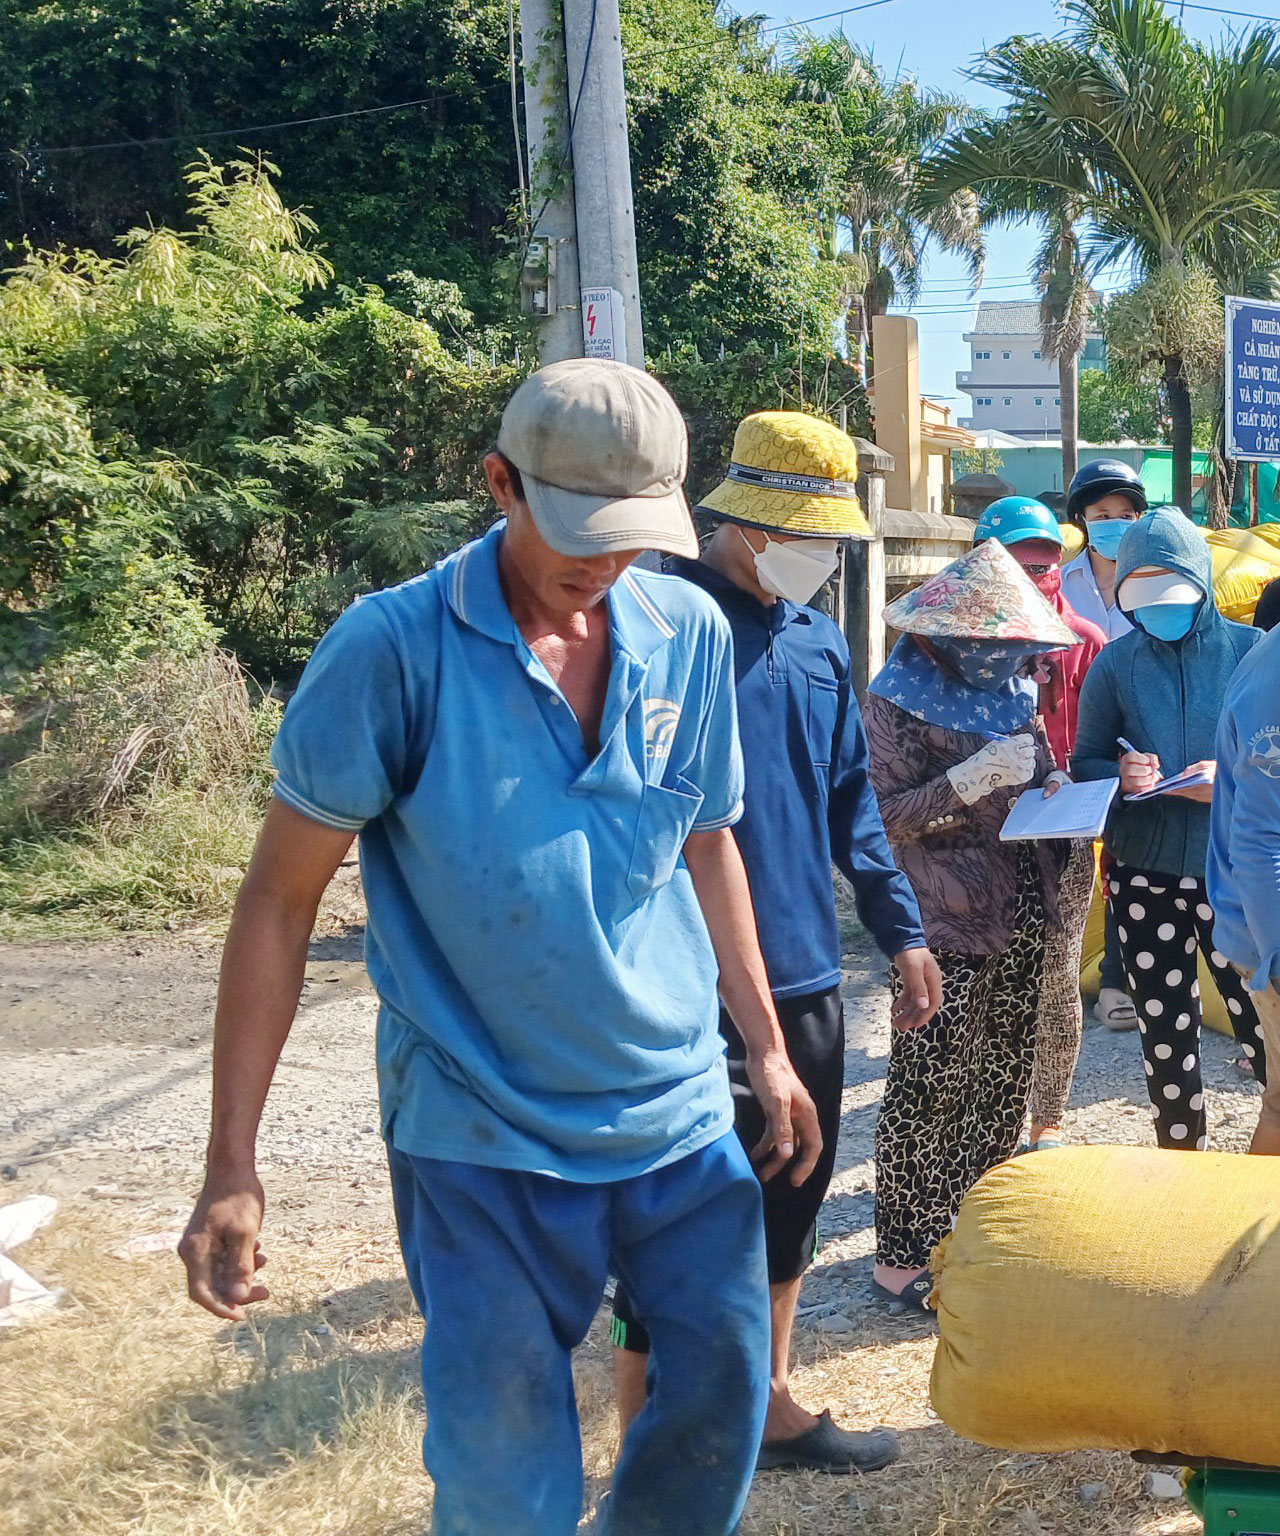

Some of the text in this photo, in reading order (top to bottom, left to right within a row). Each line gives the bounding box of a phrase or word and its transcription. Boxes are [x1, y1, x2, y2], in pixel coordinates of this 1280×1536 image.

[1244, 336, 1256, 356] CÁ
[1257, 340, 1280, 359] NHÂN
[1237, 360, 1260, 380] TÀNG
[1239, 384, 1251, 403] VÀ
[1252, 384, 1264, 404] SỬ
[1236, 406, 1259, 427] CHẤT
[1260, 410, 1278, 431] ĐỘC
[1255, 431, 1262, 451] Ở
[1263, 431, 1280, 452] TẤT
[761, 475, 831, 491] CHRISTIAN DIOR
